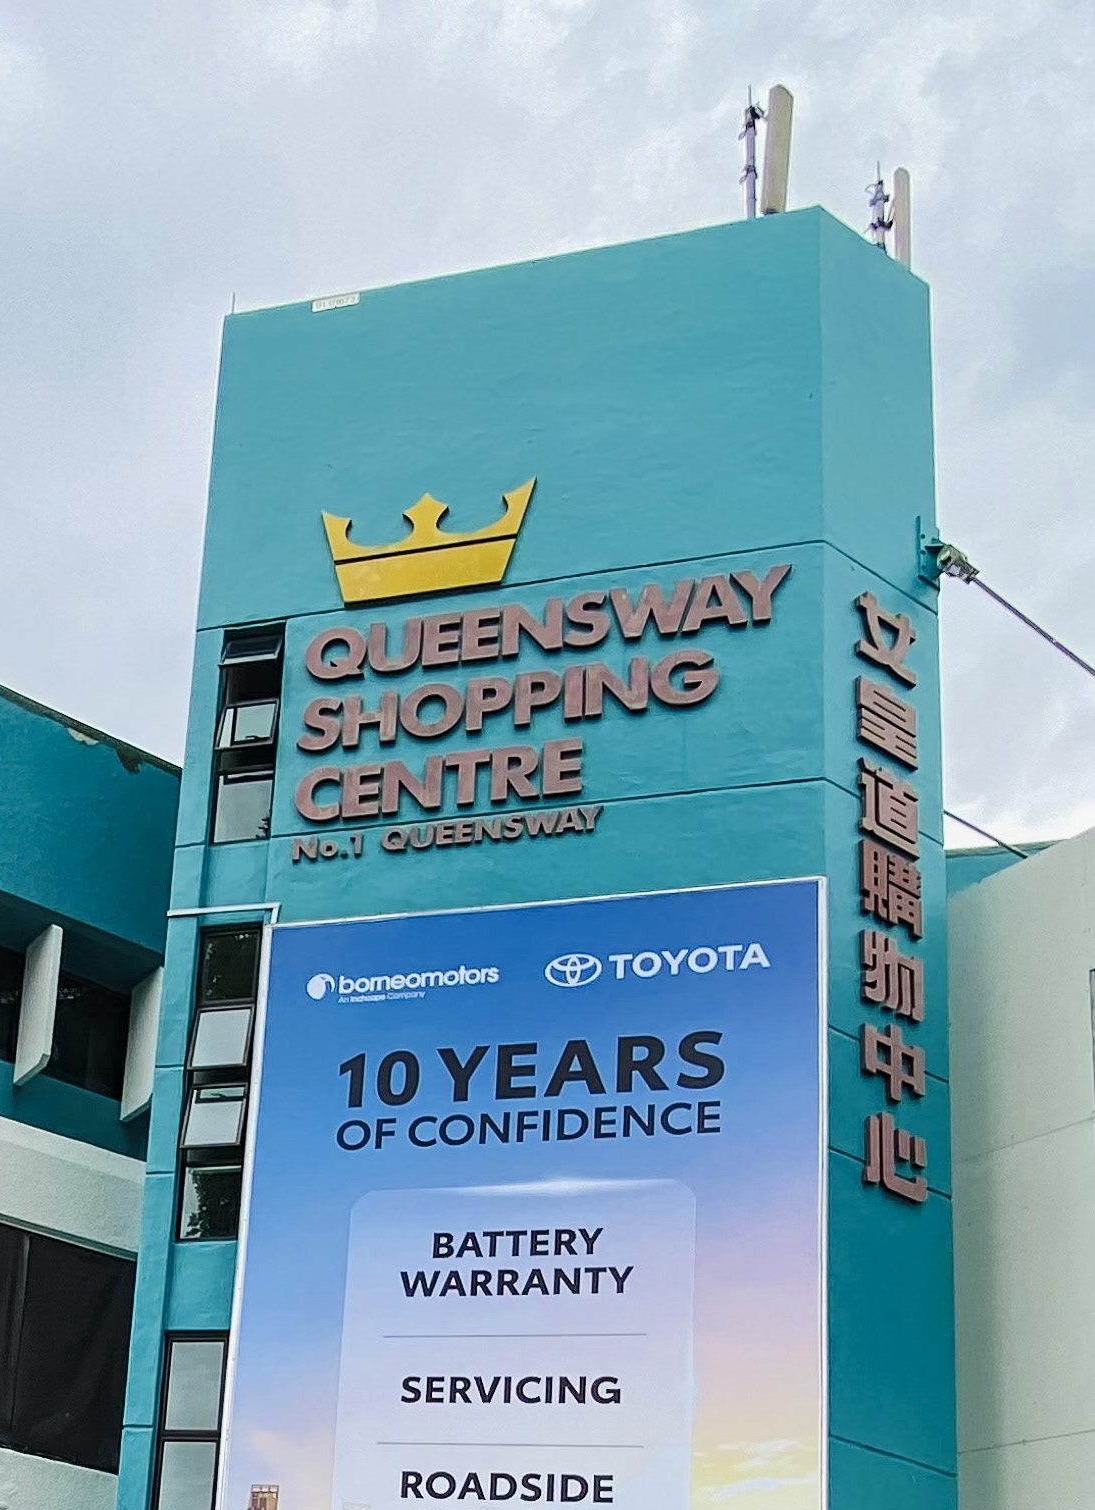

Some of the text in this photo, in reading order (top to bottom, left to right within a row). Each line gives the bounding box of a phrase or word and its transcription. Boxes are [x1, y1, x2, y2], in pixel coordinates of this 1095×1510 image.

[305, 565, 794, 680] QUEENSWAY
[297, 650, 720, 752] SHOPPING
[294, 738, 584, 822] CENTRE
[291, 804, 603, 863] No.1 QUEENSWAY
[855, 591, 927, 1203] 女皇道購物中心
[338, 965, 500, 994] borneomotors
[608, 943, 770, 980] TOYOTA
[338, 1031, 725, 1109] 10 YEARS
[336, 1101, 721, 1151] OF CONFIDENCE
[432, 1227, 603, 1259] BATTERY
[400, 1266, 634, 1298] WARRANTY
[401, 1376, 622, 1404] SERVICING
[400, 1471, 614, 1503] ROADSIDE
